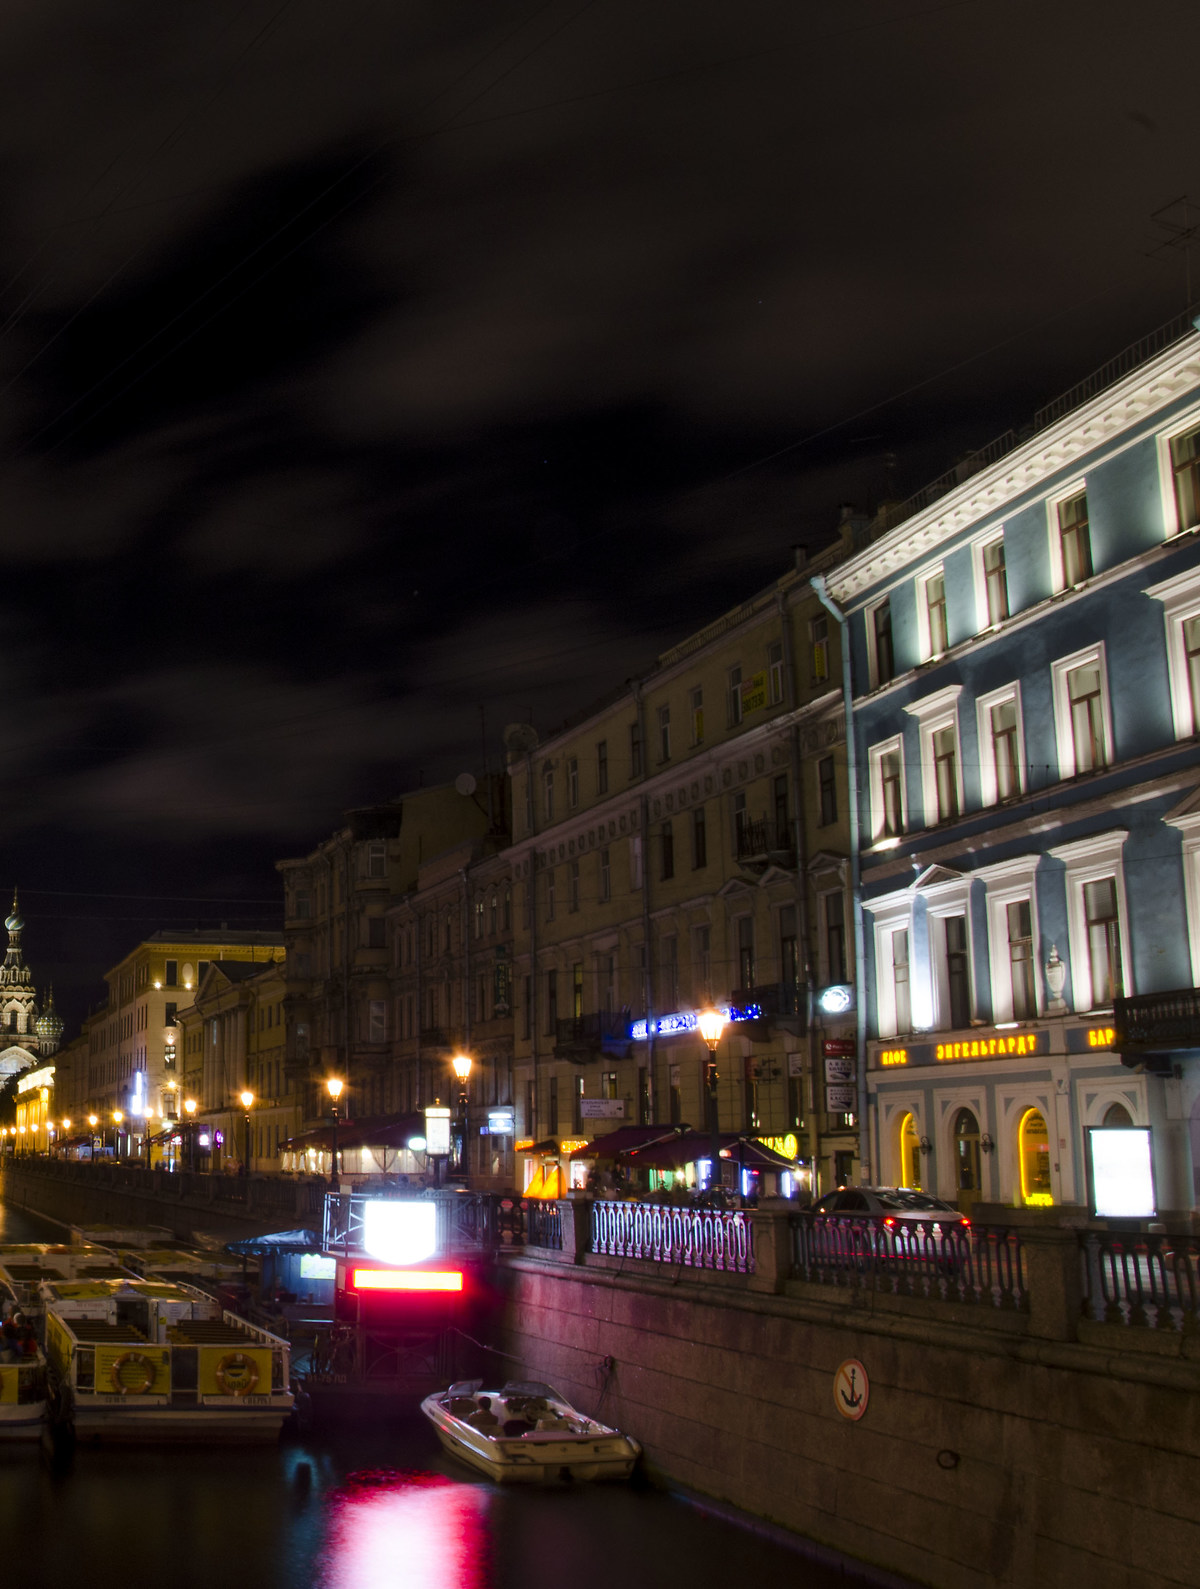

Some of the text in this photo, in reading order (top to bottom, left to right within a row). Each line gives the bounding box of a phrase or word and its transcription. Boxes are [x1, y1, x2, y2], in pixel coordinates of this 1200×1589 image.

[1088, 1028, 1115, 1046] БАР
[881, 1034, 1036, 1065] КАФЕ ЭНГЕЛЬГАРДТ
